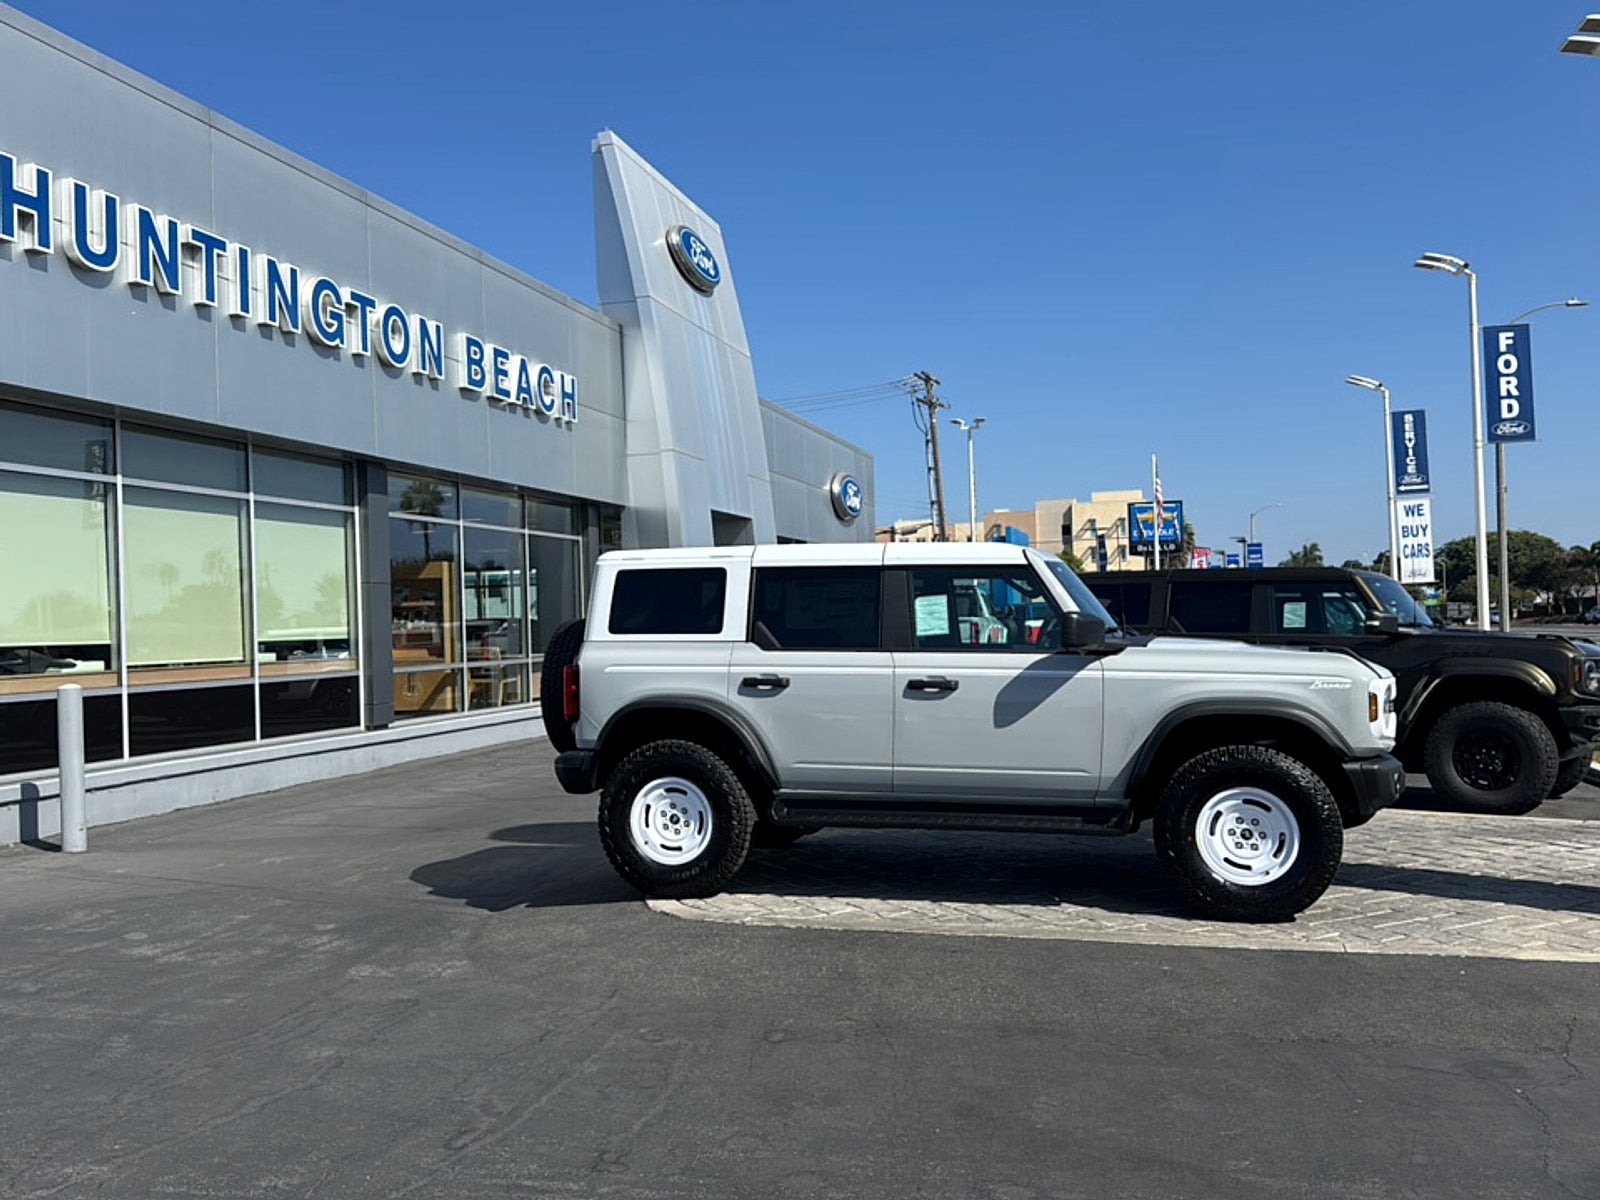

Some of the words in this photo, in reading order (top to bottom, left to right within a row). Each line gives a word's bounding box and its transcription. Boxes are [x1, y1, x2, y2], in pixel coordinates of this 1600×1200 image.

[690, 236, 716, 277] Ford
[0, 151, 445, 380] HUNTINGTON
[462, 332, 578, 424] BEACH
[1497, 332, 1520, 419] FORD
[1496, 422, 1526, 435] Ford
[1403, 413, 1417, 474] SERVICE
[1403, 503, 1425, 518] WE
[1401, 523, 1429, 539] BUY
[1402, 542, 1431, 560] CARS
